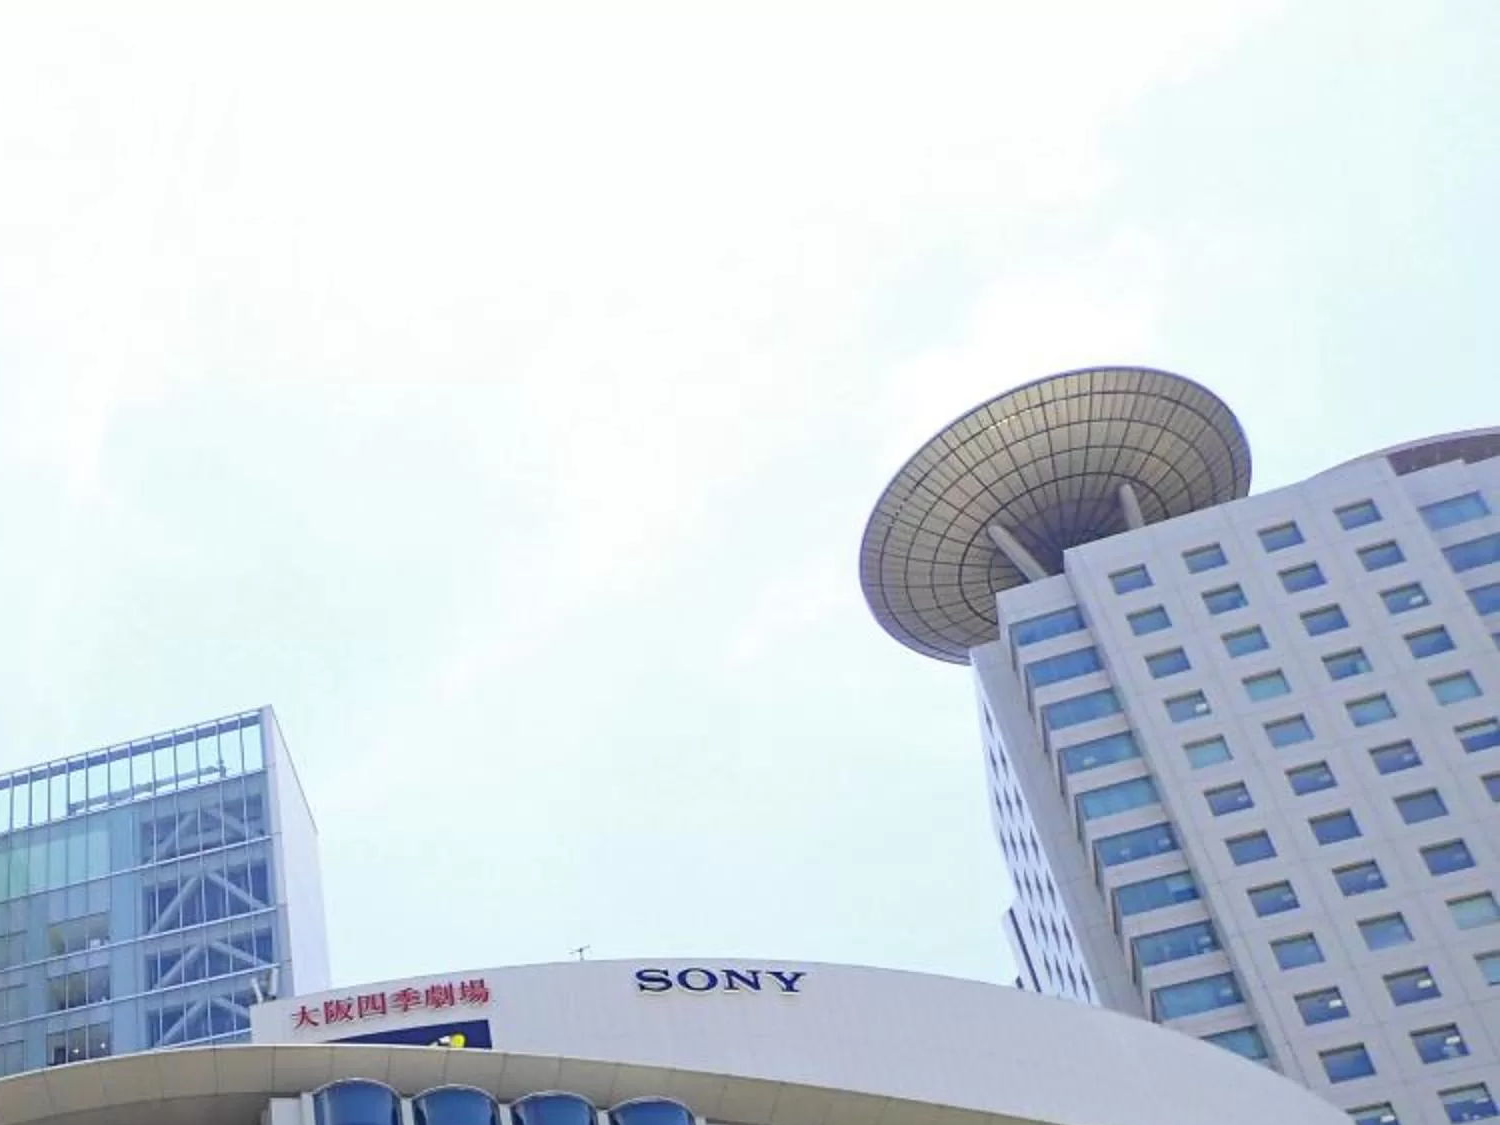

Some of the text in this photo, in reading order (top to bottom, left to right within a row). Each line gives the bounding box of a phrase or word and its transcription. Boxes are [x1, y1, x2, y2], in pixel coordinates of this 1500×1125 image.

[635, 967, 806, 992] SONY
[292, 979, 489, 1029] 大阪四季劇場
